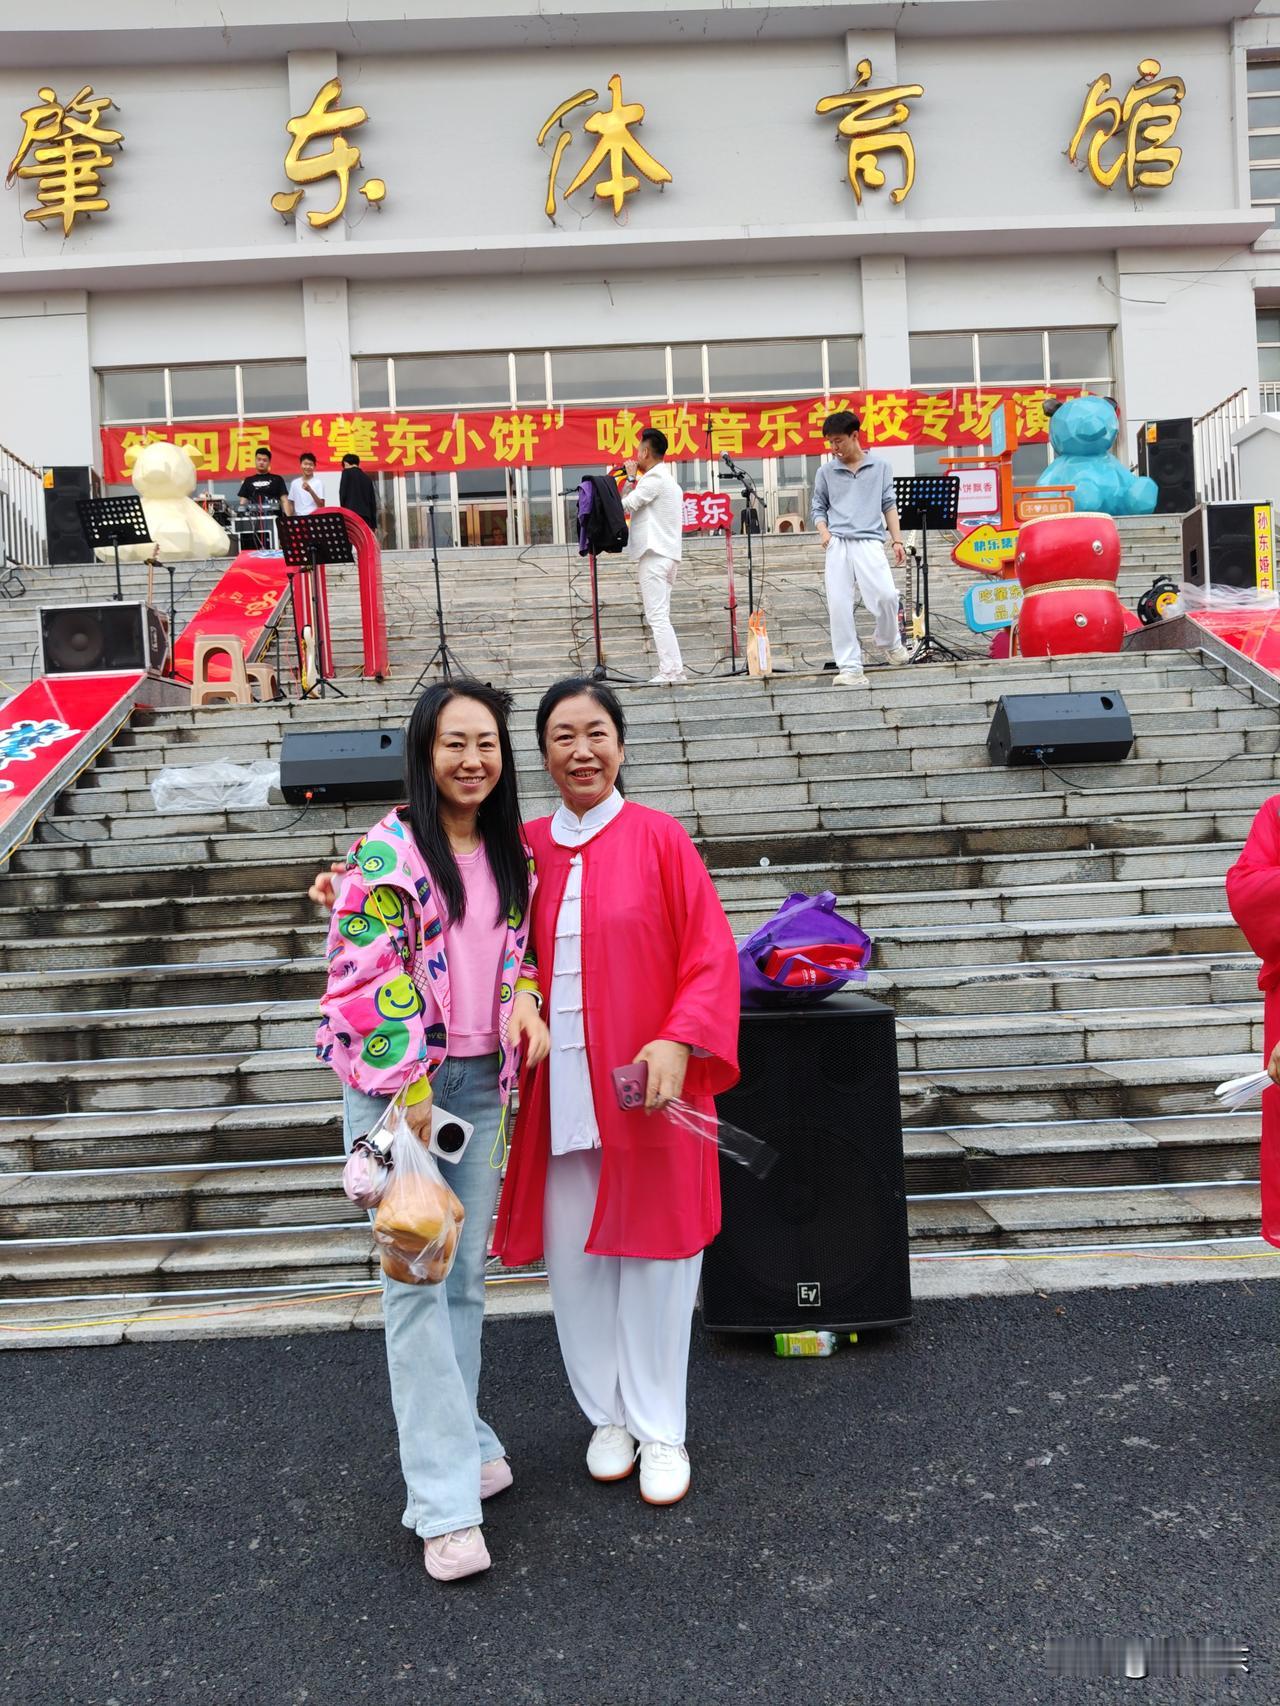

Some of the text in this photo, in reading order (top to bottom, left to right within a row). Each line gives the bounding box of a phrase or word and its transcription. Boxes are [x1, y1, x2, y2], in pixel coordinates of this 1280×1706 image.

[6, 58, 1188, 238] 肇东体育馆
[959, 481, 993, 493] 饼飘香
[974, 537, 1018, 552] 快乐集
